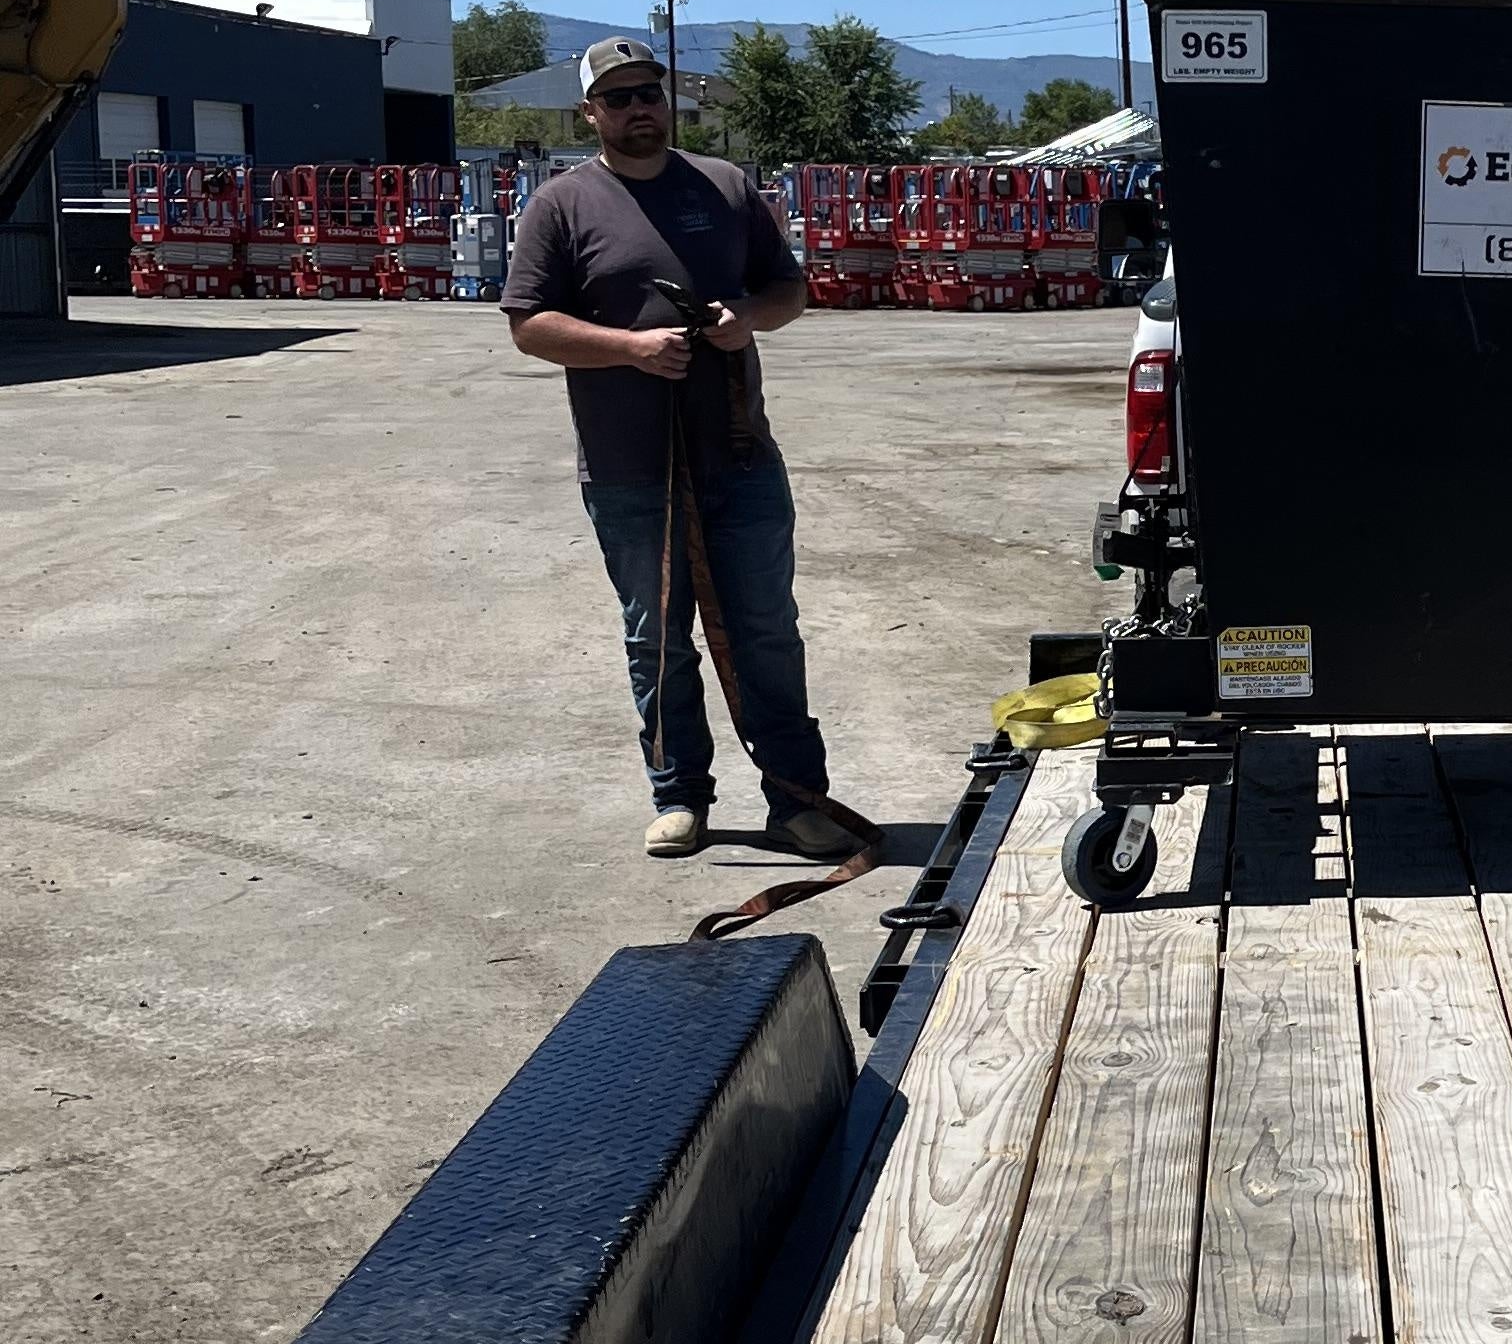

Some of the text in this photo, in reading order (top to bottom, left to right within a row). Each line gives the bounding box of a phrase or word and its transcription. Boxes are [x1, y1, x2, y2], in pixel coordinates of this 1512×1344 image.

[1181, 31, 1248, 59] 965
[1194, 68, 1221, 76] EMPTY
[1235, 629, 1305, 641] CAUTION
